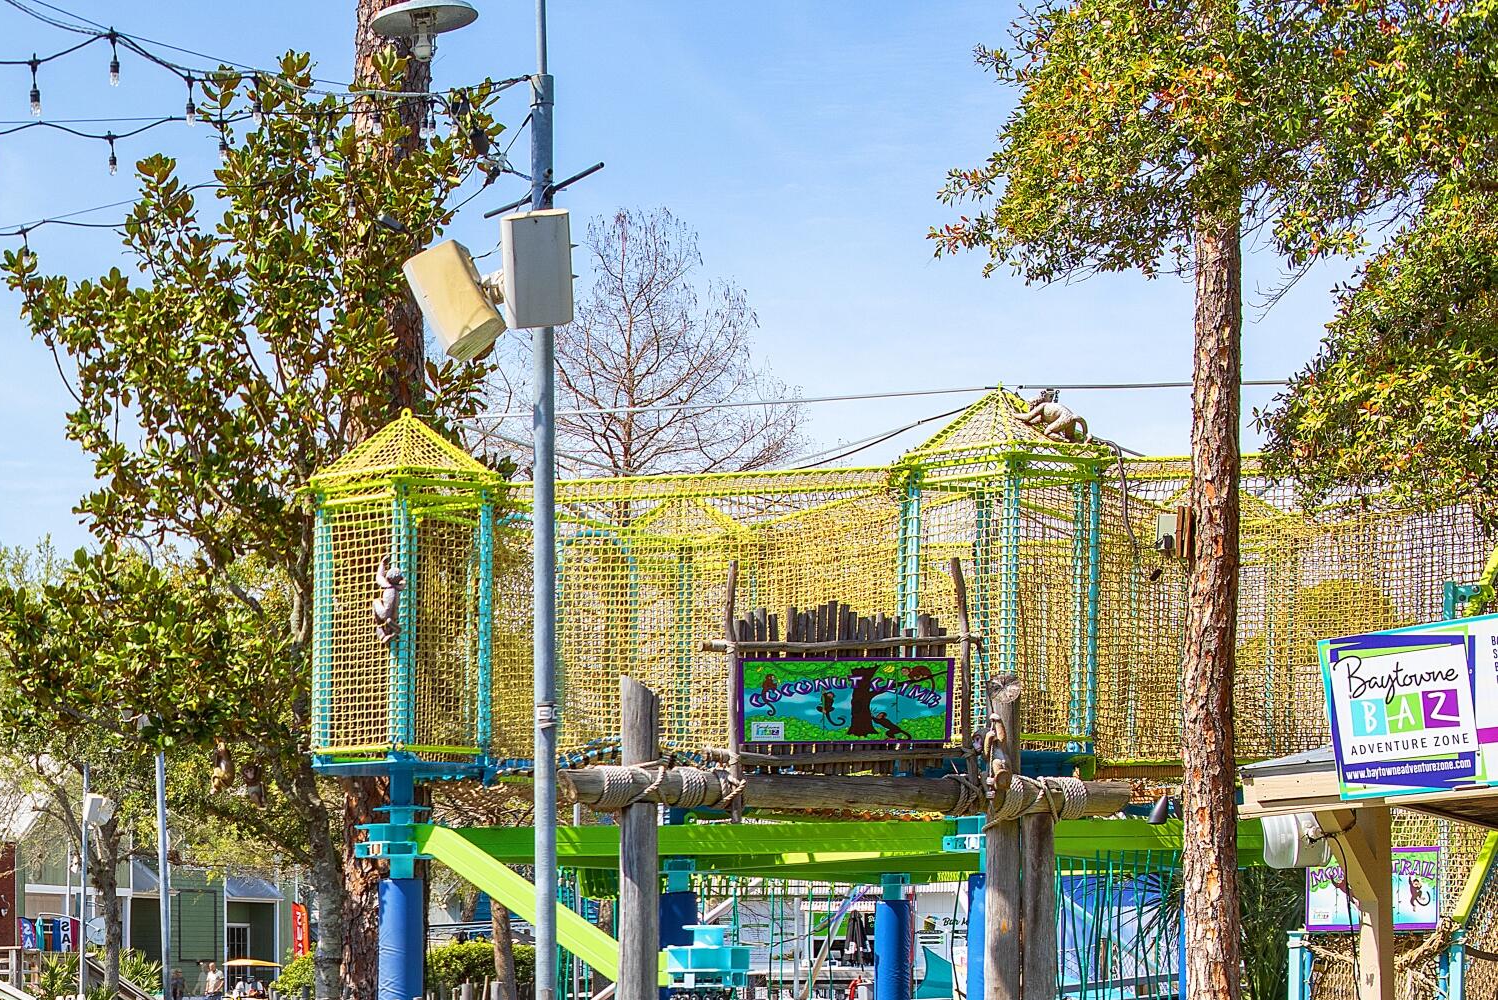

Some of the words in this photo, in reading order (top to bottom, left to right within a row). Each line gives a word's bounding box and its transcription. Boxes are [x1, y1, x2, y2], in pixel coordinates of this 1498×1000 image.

[749, 675, 863, 708] COCONUT
[870, 677, 942, 708] CLIMB
[1333, 655, 1458, 704] Baytowne
[1361, 691, 1460, 734] BAZ
[1350, 736, 1428, 756] ADVENTURE
[1434, 732, 1470, 747] ZONE
[1346, 758, 1472, 780] www.baytowneadventurezone.com
